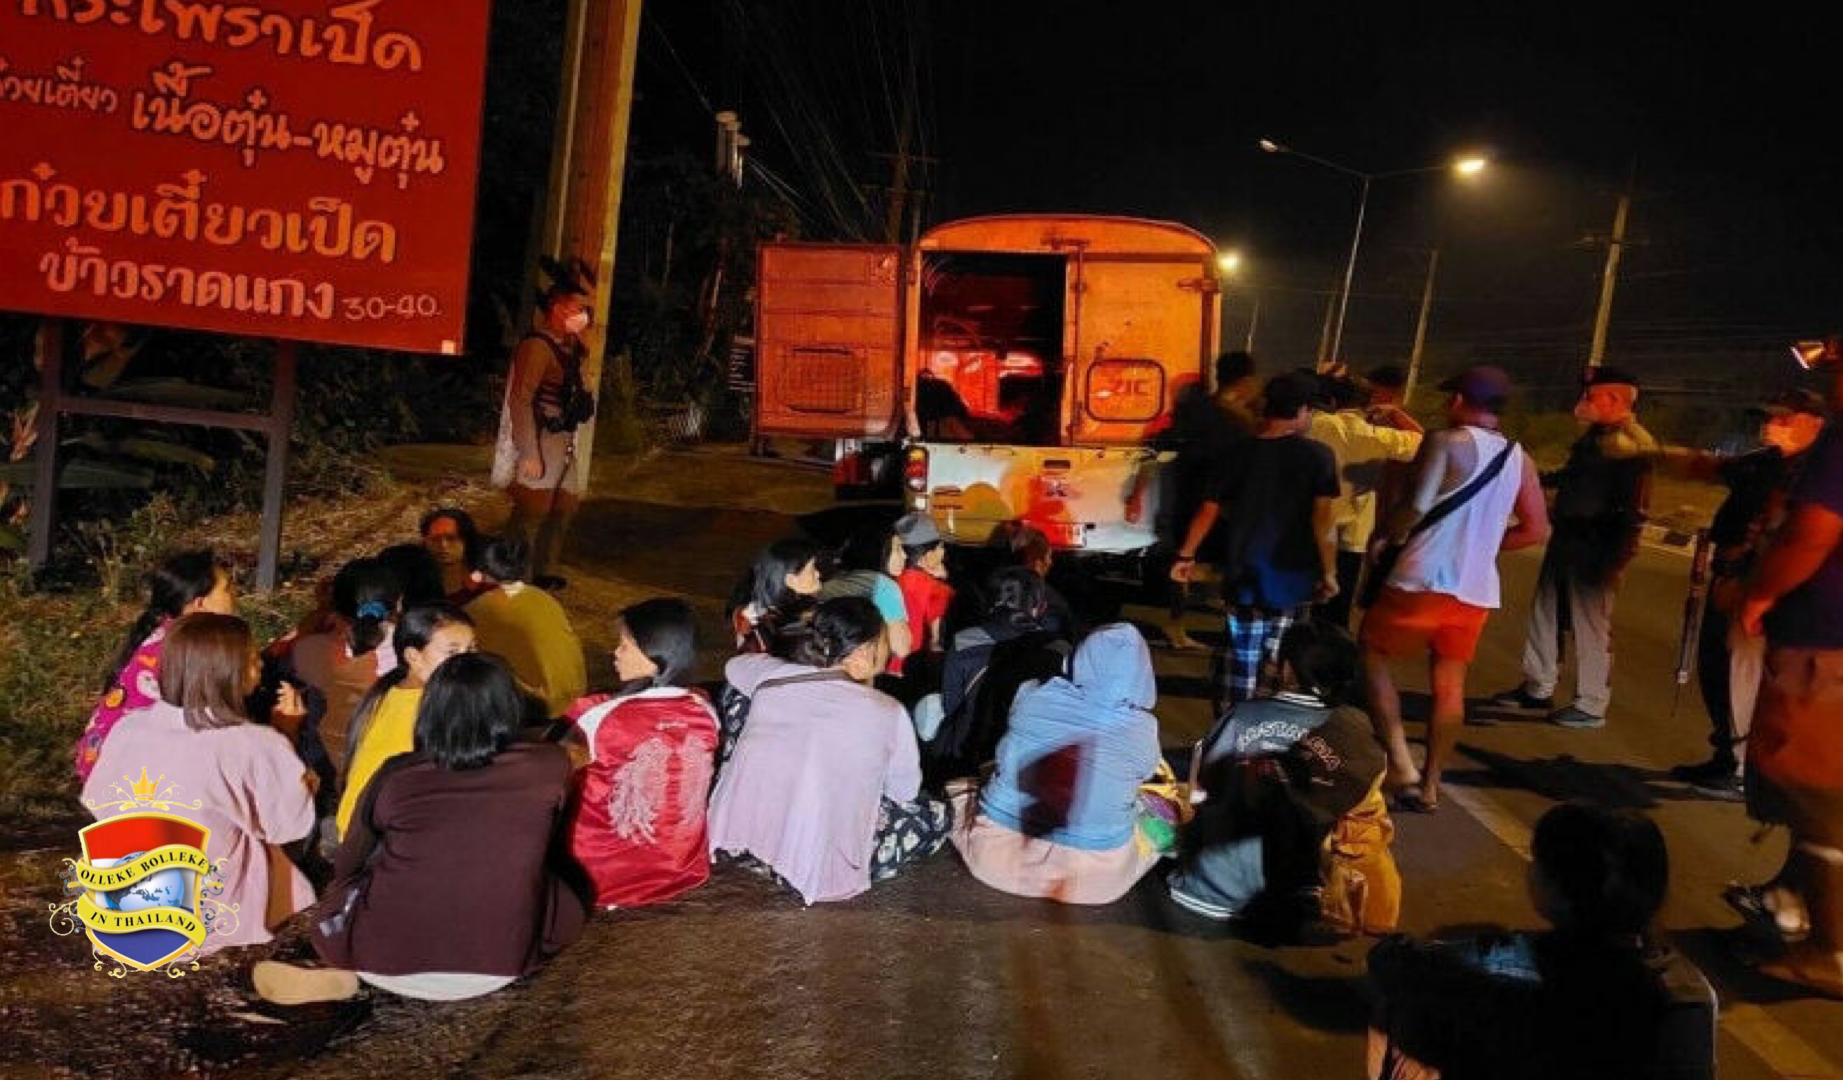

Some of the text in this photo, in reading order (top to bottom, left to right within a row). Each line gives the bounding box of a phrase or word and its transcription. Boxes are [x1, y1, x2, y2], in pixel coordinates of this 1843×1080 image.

[0, 56, 118, 113] ๋วยเตี๋ยว
[0, 162, 396, 263] ก๋วยเตี๋ยวเป็ด
[39, 237, 335, 320] ข้าวราดแกง
